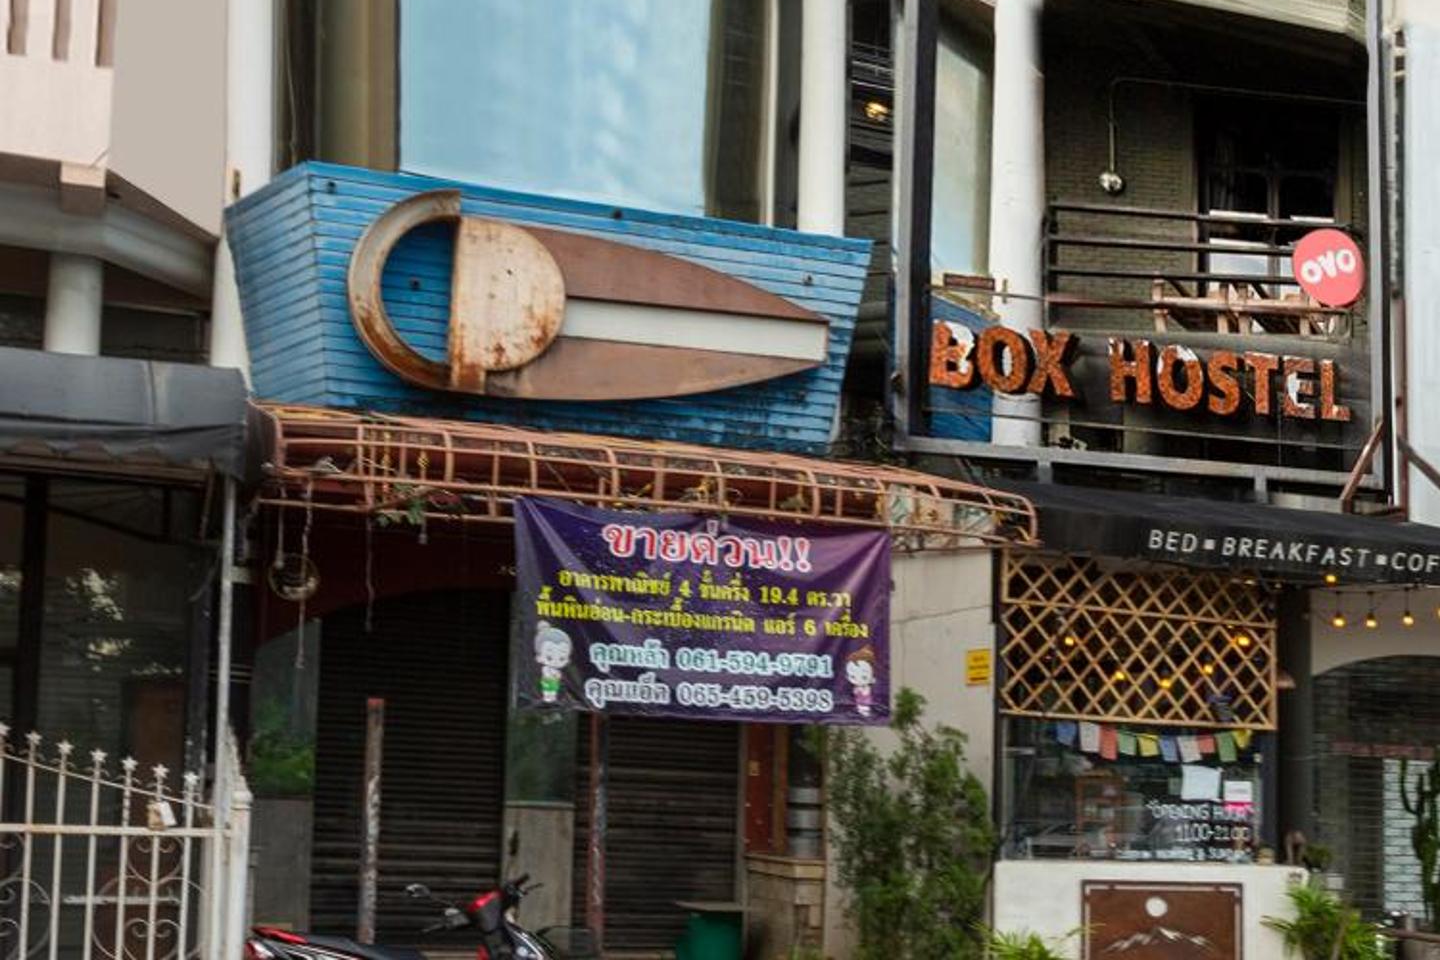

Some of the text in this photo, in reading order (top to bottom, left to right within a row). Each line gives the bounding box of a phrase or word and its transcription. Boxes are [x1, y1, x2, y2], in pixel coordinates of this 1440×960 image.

[928, 318, 1351, 422] BOX HOSTEL
[602, 519, 813, 572] ขายด่วน!!
[1148, 529, 1197, 553] BED
[1221, 536, 1370, 568] BREAKFAST
[679, 580, 694, 598] 4
[759, 586, 799, 606] 19.4
[803, 619, 817, 636] 6
